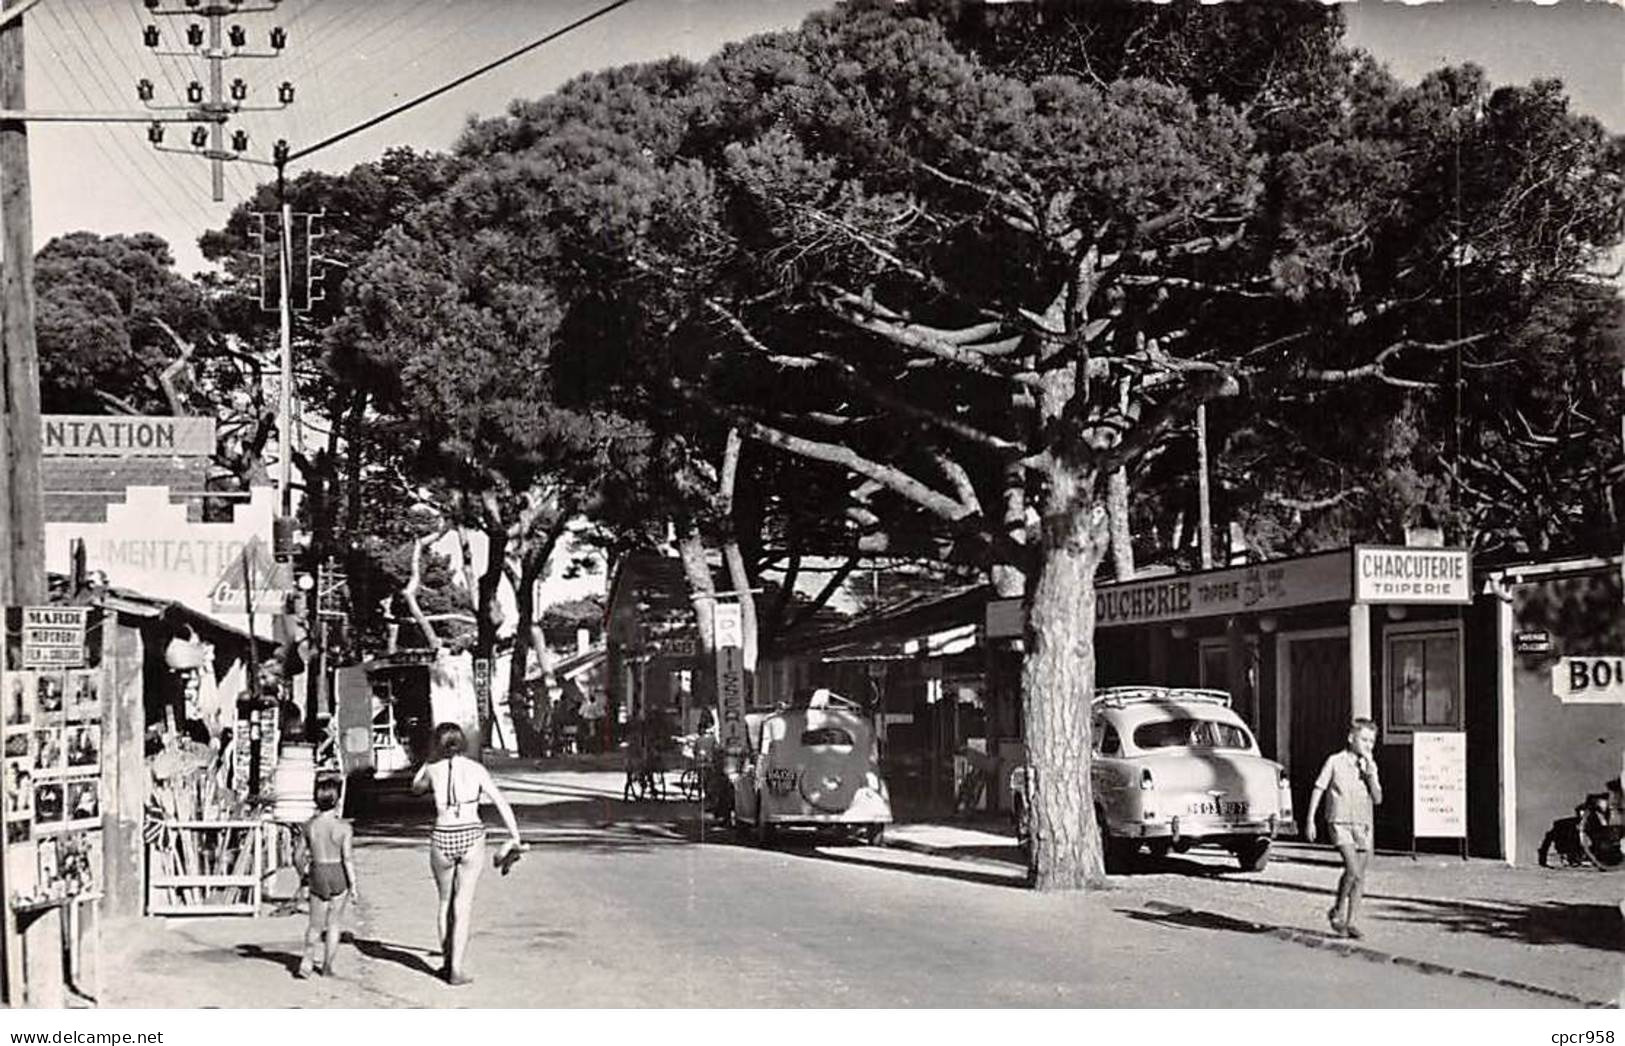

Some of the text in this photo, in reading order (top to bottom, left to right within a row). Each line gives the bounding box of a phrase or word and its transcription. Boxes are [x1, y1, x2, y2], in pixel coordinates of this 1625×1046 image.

[46, 421, 174, 448] NTATION
[1362, 554, 1463, 579] CHARCUTERIE
[1096, 581, 1192, 620] OUCHERIE
[1374, 583, 1452, 595] TRIPERIE
[29, 612, 81, 624] MARDI
